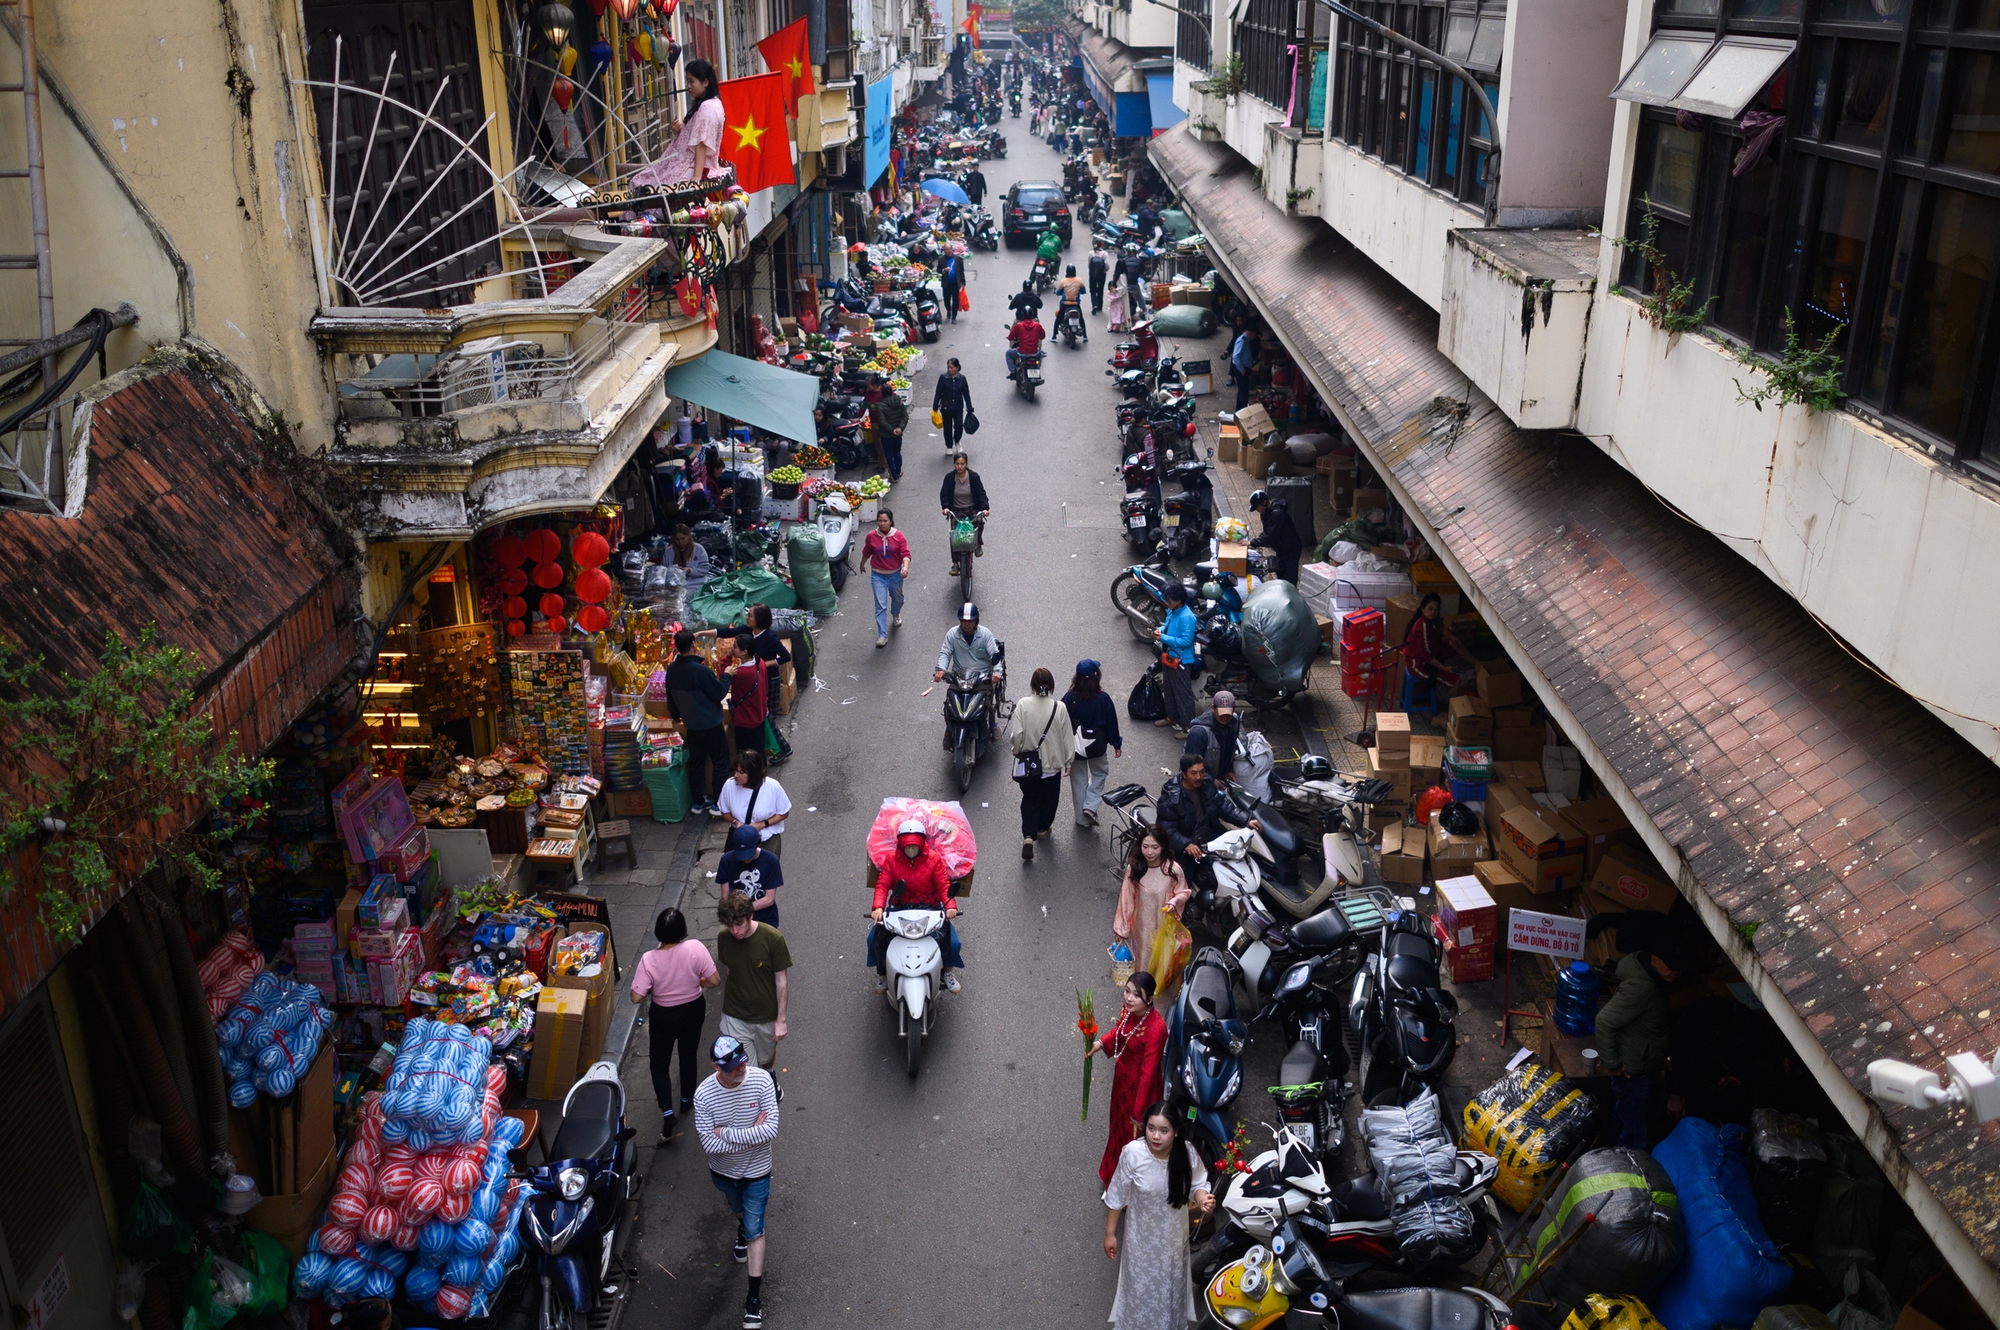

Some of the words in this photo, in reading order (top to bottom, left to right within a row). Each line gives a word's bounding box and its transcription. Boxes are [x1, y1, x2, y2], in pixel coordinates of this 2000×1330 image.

[578, 902, 598, 916] MENU
[1514, 931, 1529, 944] CẤM
[1565, 939, 1569, 950] Ô
[1572, 941, 1580, 952] TÔ
[1570, 931, 1581, 940] CHỢ
